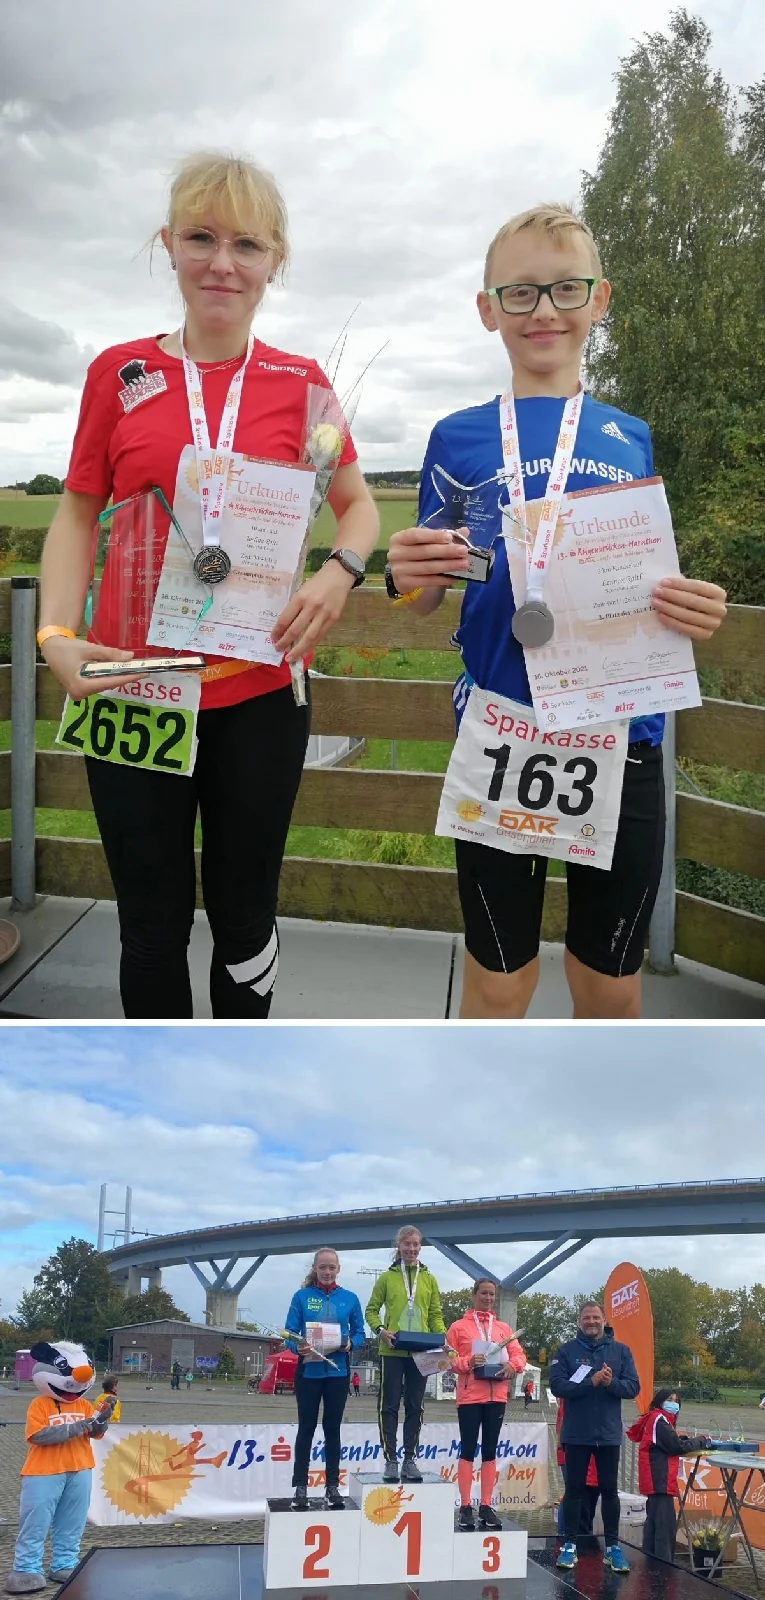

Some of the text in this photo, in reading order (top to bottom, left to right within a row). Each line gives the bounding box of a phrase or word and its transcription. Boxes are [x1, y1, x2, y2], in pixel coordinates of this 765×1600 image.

[237, 480, 300, 502] Urkunde
[571, 510, 651, 537] Urkunde
[614, 702, 635, 713] BLITZ
[62, 697, 187, 770] 2652
[484, 743, 598, 817] 163
[496, 827, 557, 846] Gesundheit
[497, 809, 559, 836] DAK
[612, 1280, 640, 1309] DAK
[227, 1439, 265, 1470] 13.
[507, 1463, 537, 1488] Day
[302, 1524, 331, 1580] 2
[392, 1511, 422, 1576] 1
[482, 1536, 501, 1573] 3
